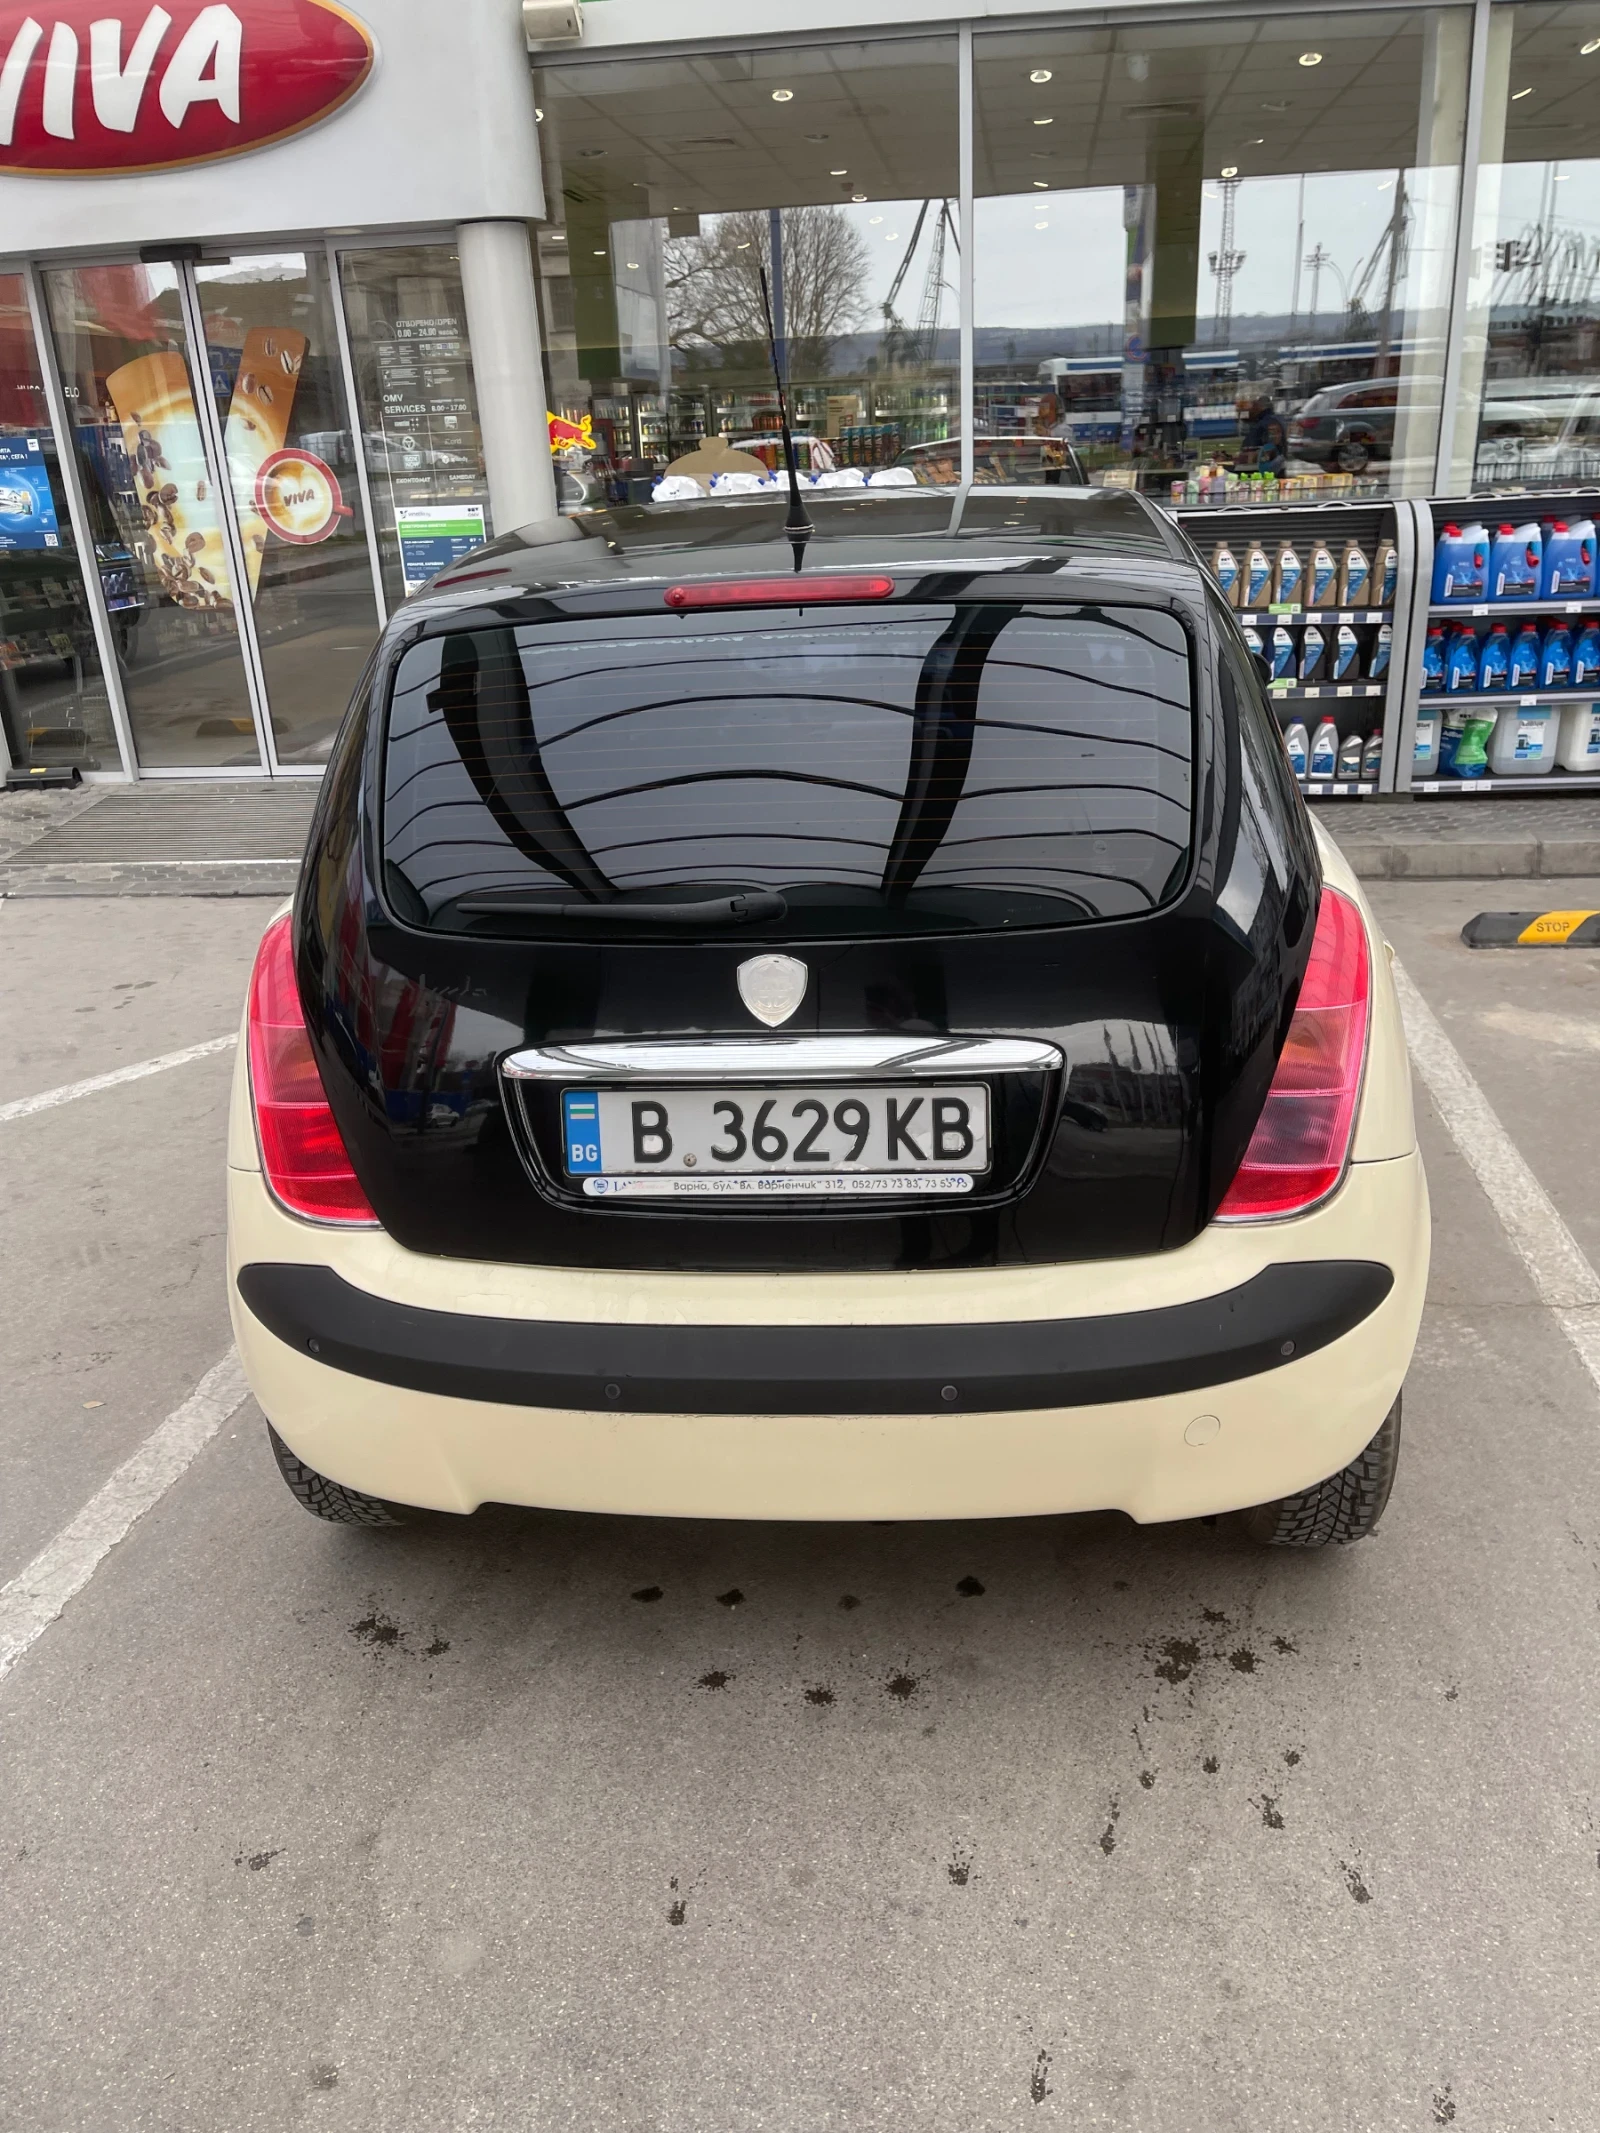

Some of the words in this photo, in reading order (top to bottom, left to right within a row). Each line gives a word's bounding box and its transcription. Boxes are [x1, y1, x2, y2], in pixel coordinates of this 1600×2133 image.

[383, 394, 403, 403] OMV
[384, 404, 427, 414] SERVICES
[284, 488, 315, 507] VIVA
[1536, 922, 1570, 933] STOP
[710, 1098, 871, 1163] 3629
[572, 1144, 598, 1162] BG
[673, 1181, 710, 1192] Варна,
[852, 1179, 888, 1189] 052/73
[891, 1179, 902, 1189] 73
[925, 1178, 937, 1188] 73
